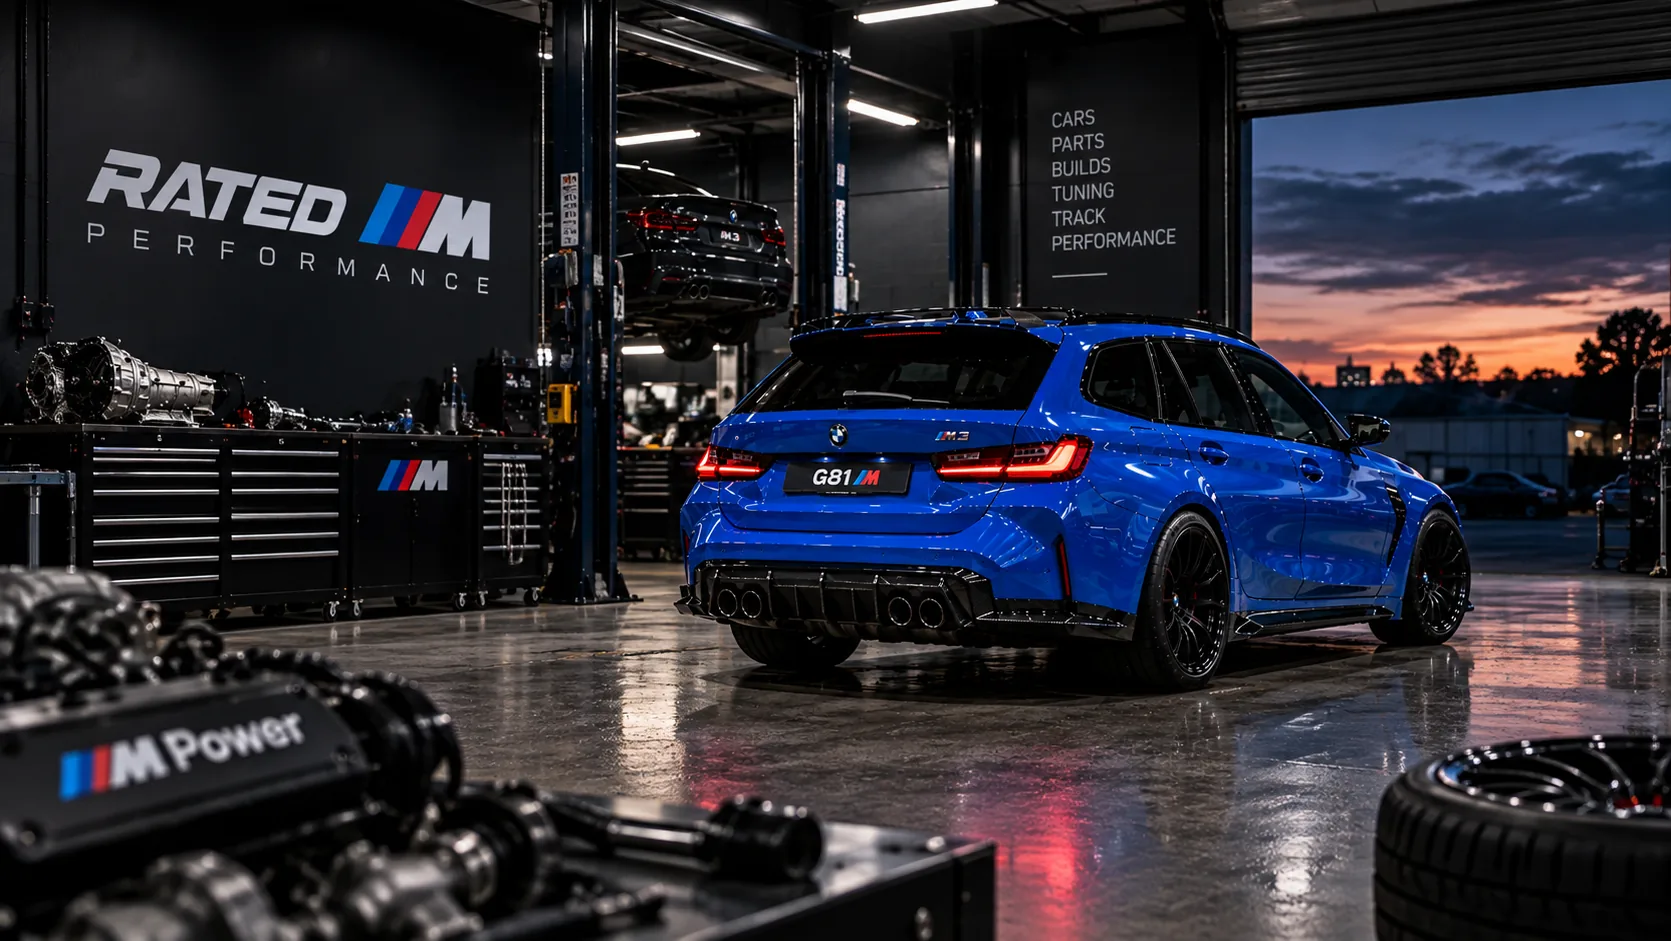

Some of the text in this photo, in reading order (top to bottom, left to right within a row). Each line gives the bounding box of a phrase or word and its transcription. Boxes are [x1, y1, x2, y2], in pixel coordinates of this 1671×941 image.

[1052, 109, 1095, 128] CARS
[1052, 133, 1105, 153] PARTS
[1052, 157, 1111, 177] BUILDS
[1052, 182, 1115, 202] TUNING
[86, 148, 347, 236] RATED
[417, 194, 491, 261] M
[1052, 207, 1106, 227] TRACK
[1052, 228, 1176, 251] PERFORMANCE
[87, 222, 489, 294] PERFORMANCE
[945, 431, 970, 441] M3
[812, 468, 852, 486] G81
[161, 712, 305, 773] Power
